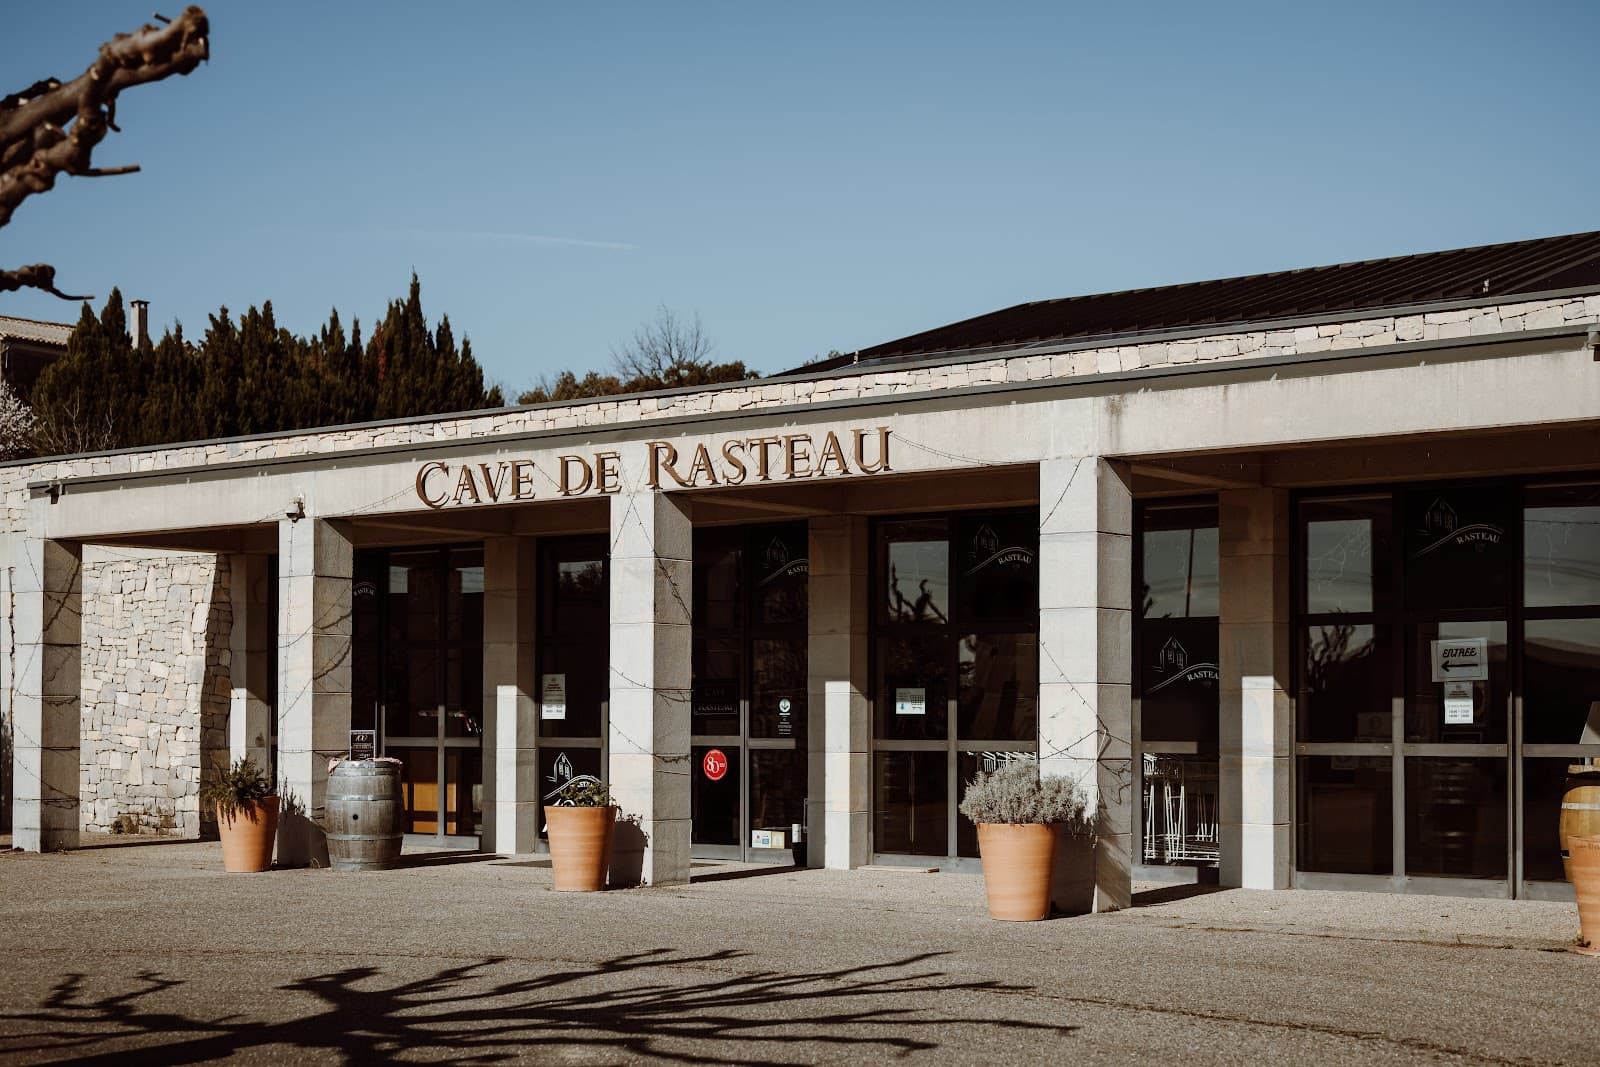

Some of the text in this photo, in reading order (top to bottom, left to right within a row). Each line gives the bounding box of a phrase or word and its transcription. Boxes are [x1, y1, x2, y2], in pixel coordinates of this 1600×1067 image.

[416, 426, 892, 508] CAVE DE RASTEAU
[1456, 532, 1500, 545] RASTEAU
[998, 554, 1032, 565] RASTEAU
